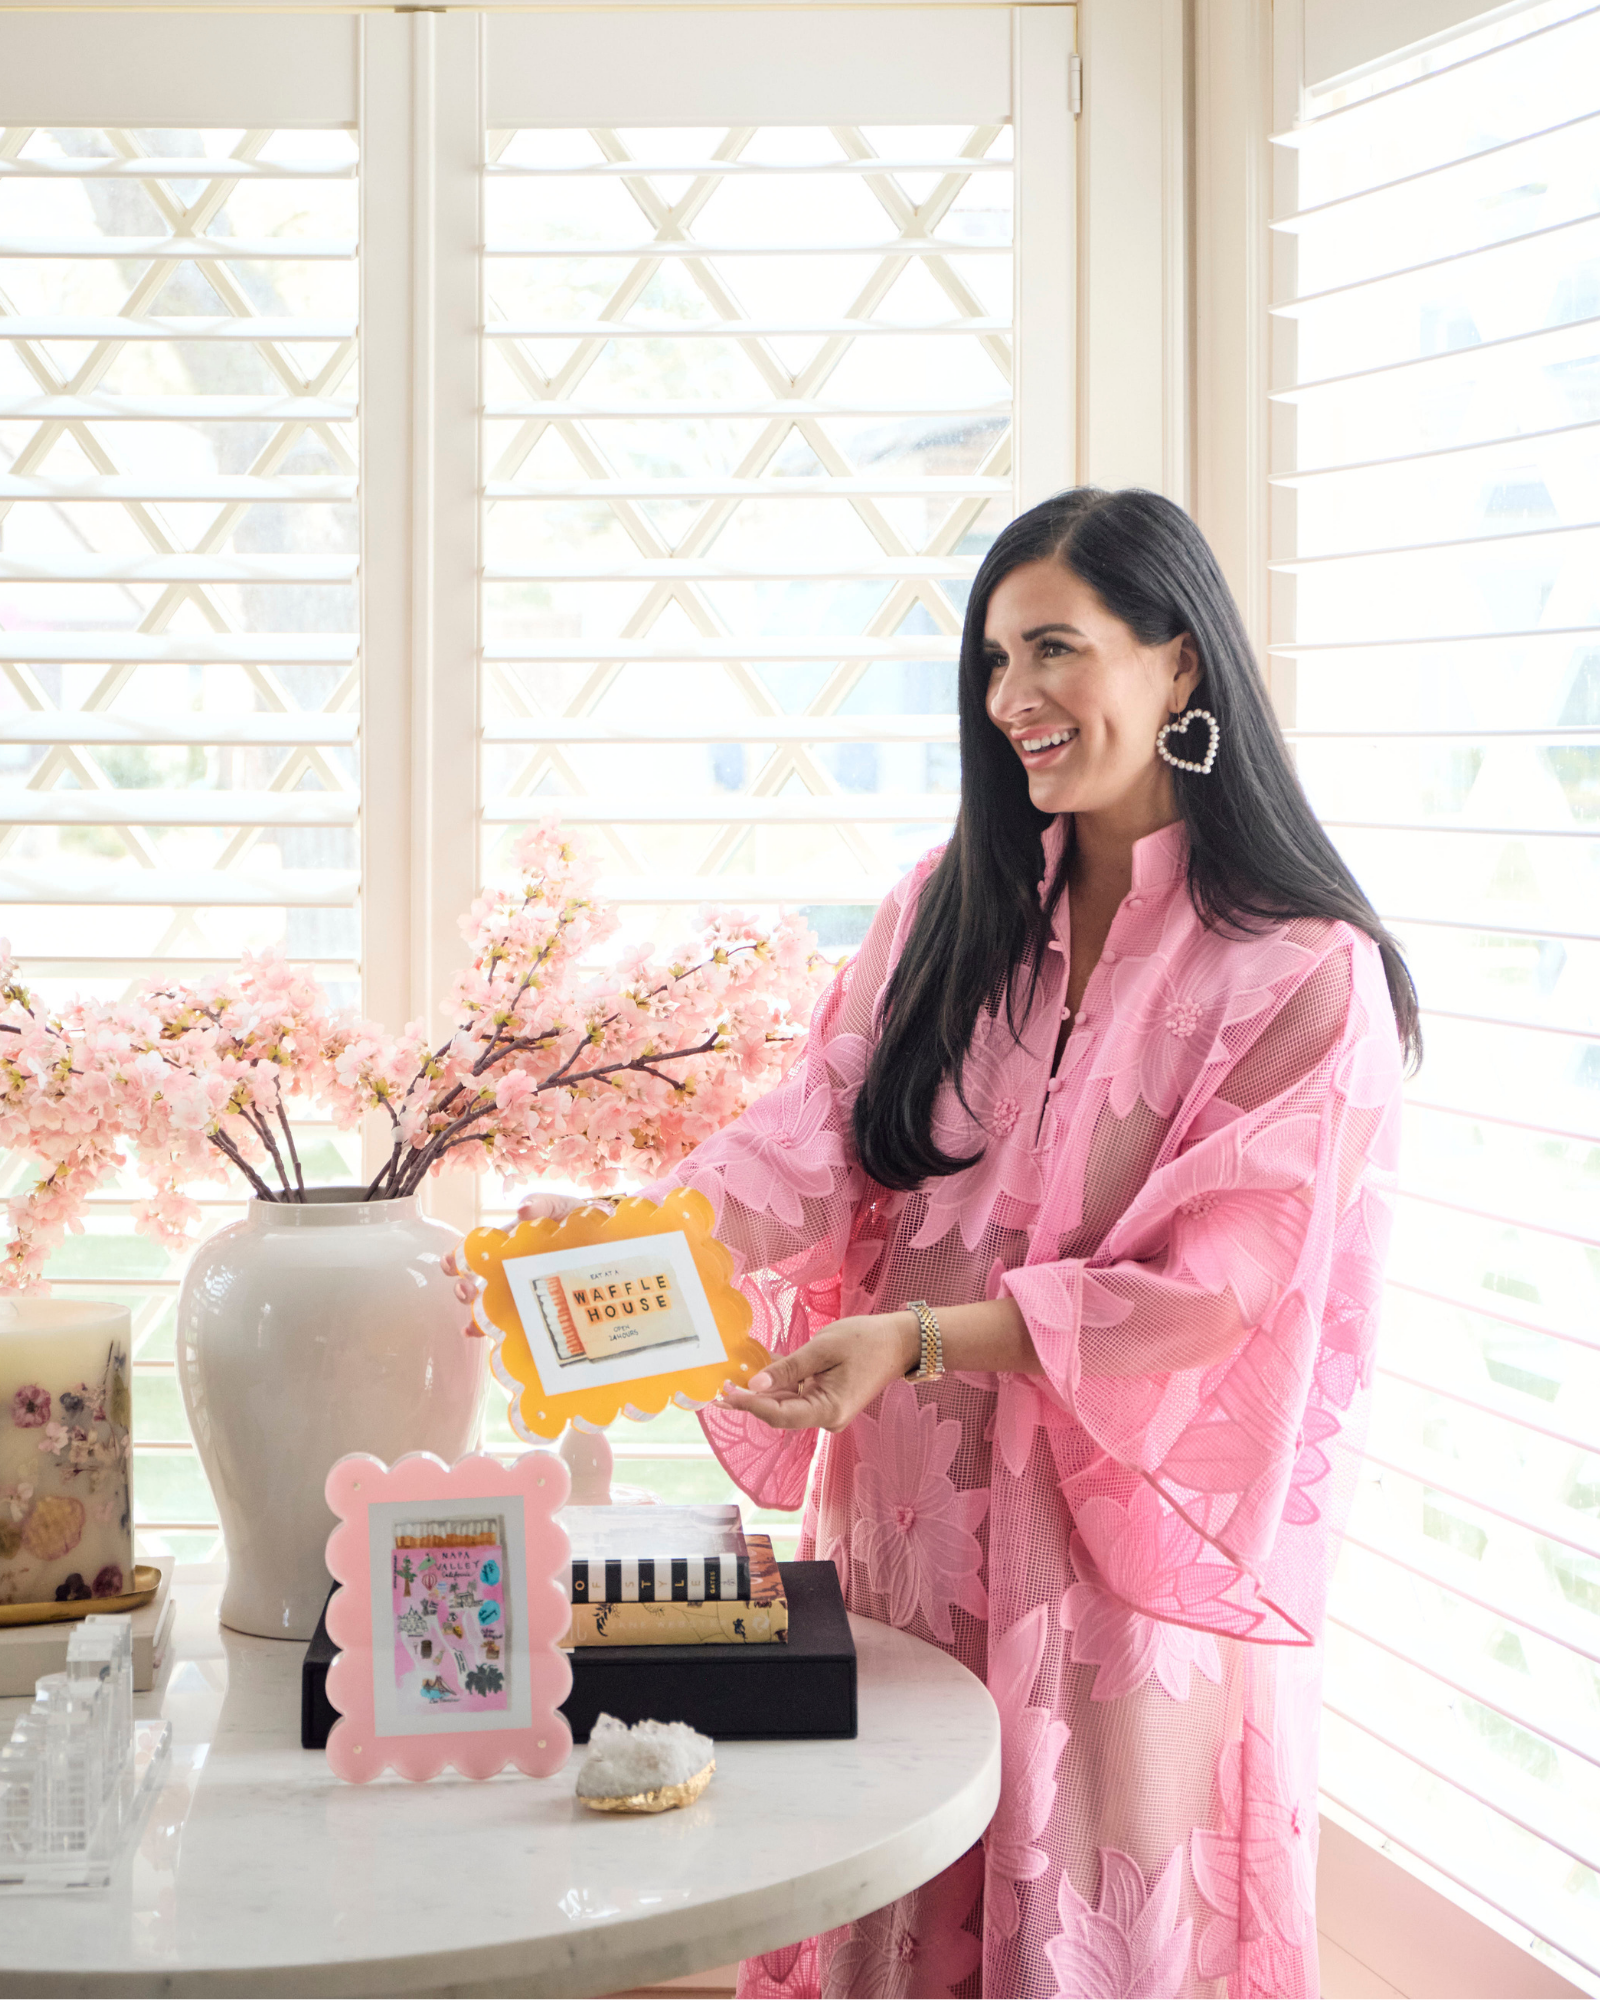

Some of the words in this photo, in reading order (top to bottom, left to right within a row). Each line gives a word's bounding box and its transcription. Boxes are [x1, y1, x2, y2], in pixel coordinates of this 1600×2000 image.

[573, 1275, 667, 1305] WAFFLE
[587, 1295, 667, 1322] HOUSE
[613, 1325, 630, 1333] OPEN
[442, 1551, 470, 1560] NAPA
[436, 1560, 479, 1571] VALLEY
